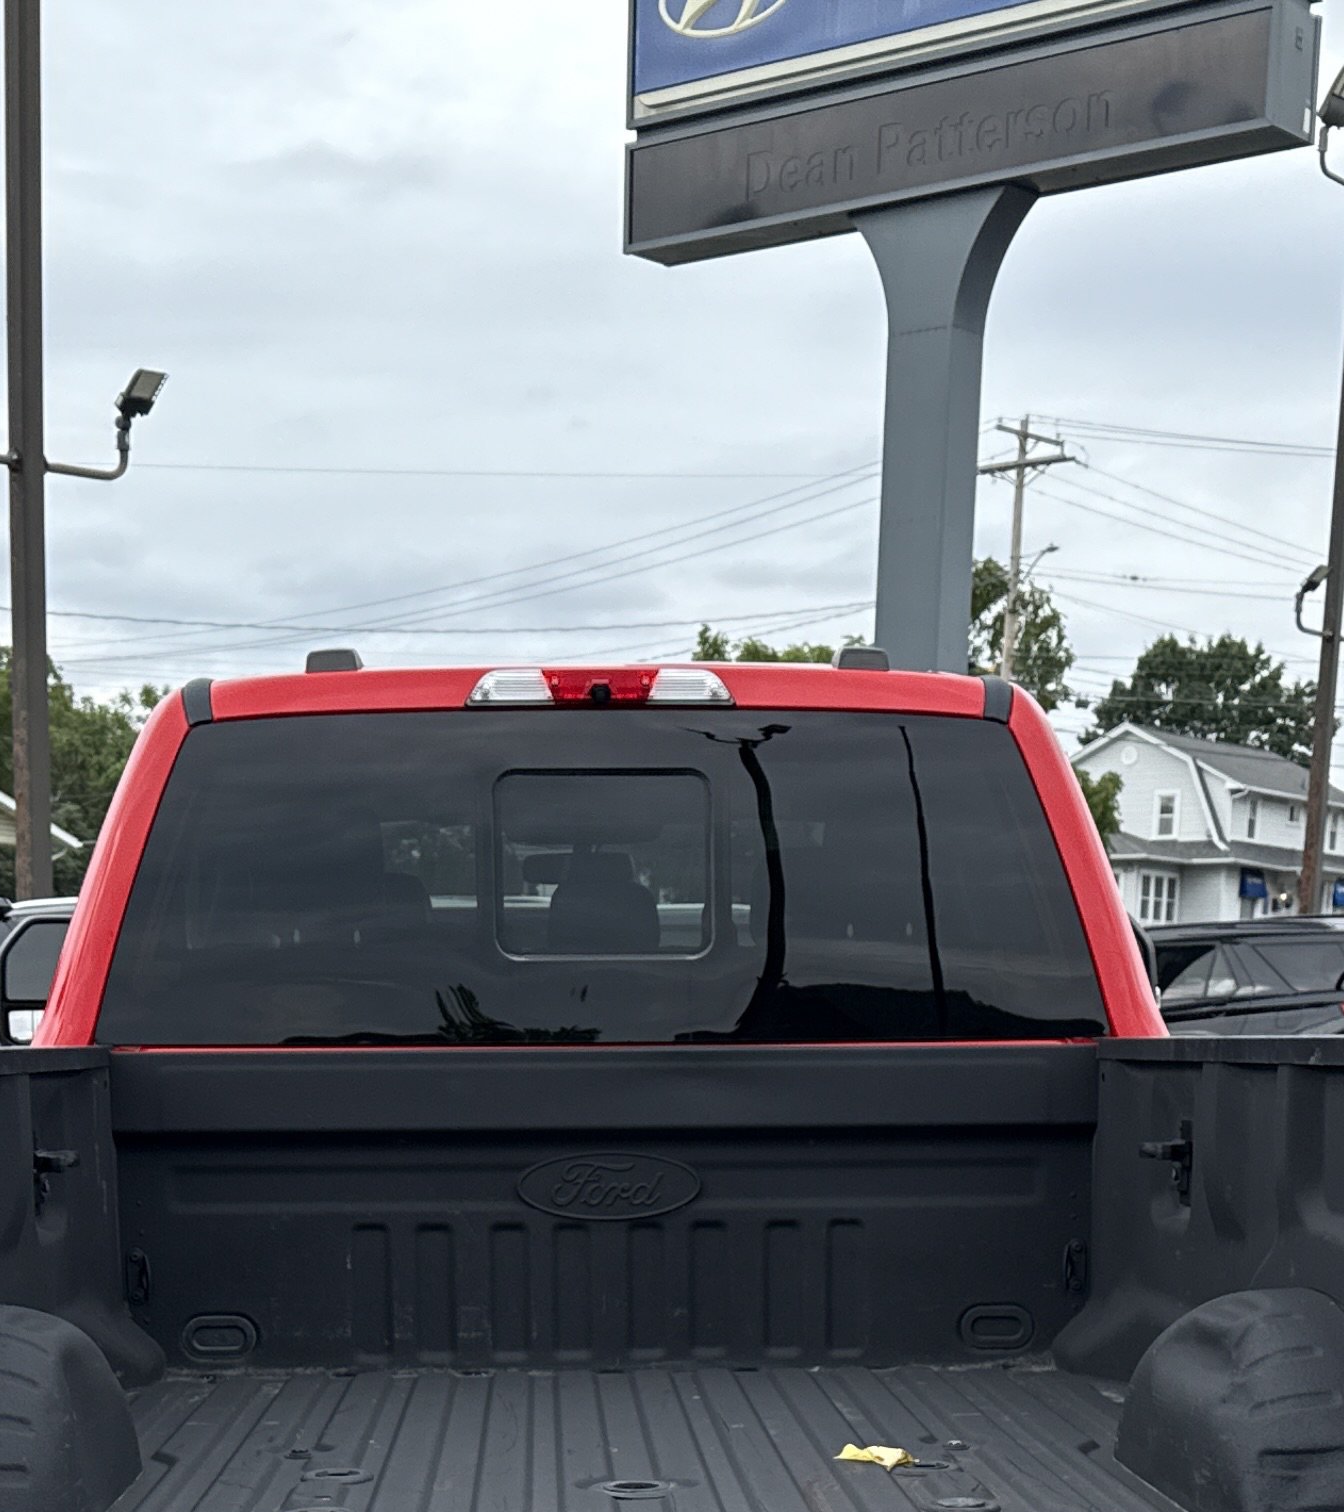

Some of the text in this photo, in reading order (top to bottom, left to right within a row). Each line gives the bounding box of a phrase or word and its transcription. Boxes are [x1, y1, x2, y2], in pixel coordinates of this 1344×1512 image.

[745, 89, 1115, 201] Dean Patterson
[552, 1162, 664, 1207] Ford
